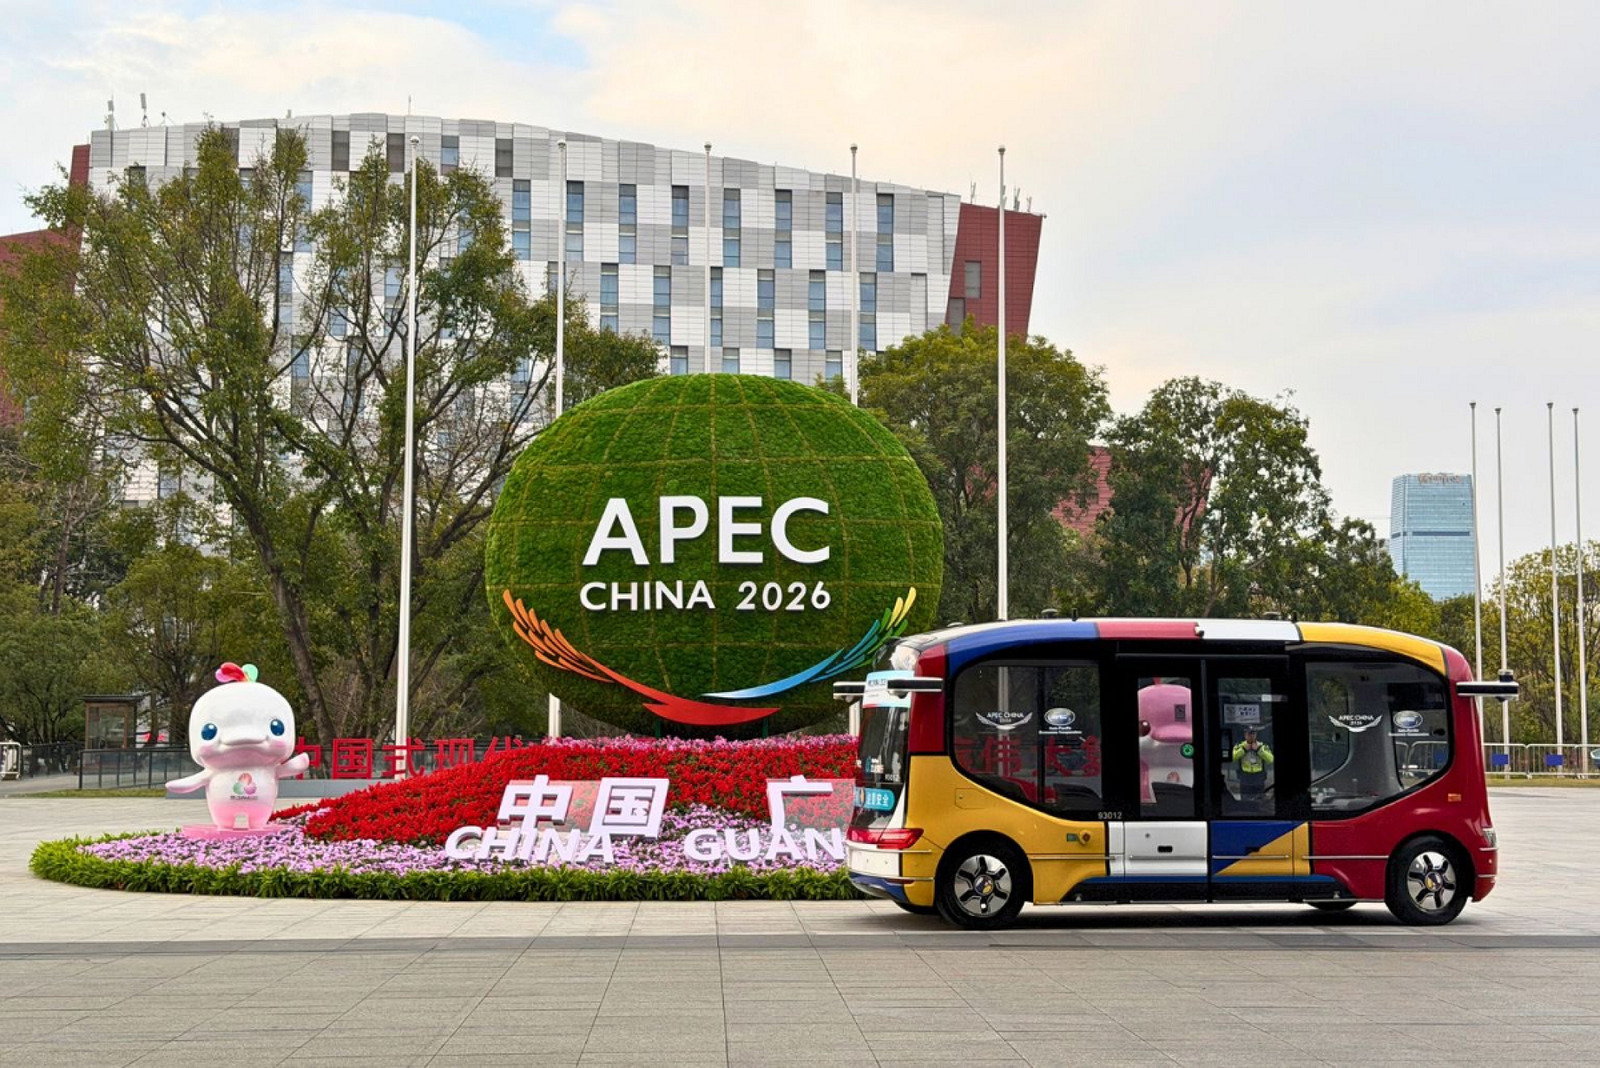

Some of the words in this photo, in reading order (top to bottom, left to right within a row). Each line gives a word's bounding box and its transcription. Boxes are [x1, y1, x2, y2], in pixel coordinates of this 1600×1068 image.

[582, 495, 830, 566] APEC
[579, 580, 716, 611] CHINA
[735, 581, 832, 611] 2026
[498, 774, 670, 839] 中国
[767, 775, 833, 835] 广
[1098, 811, 1123, 820] 93012
[445, 826, 615, 864] CHINA
[683, 827, 847, 862] GUAN
